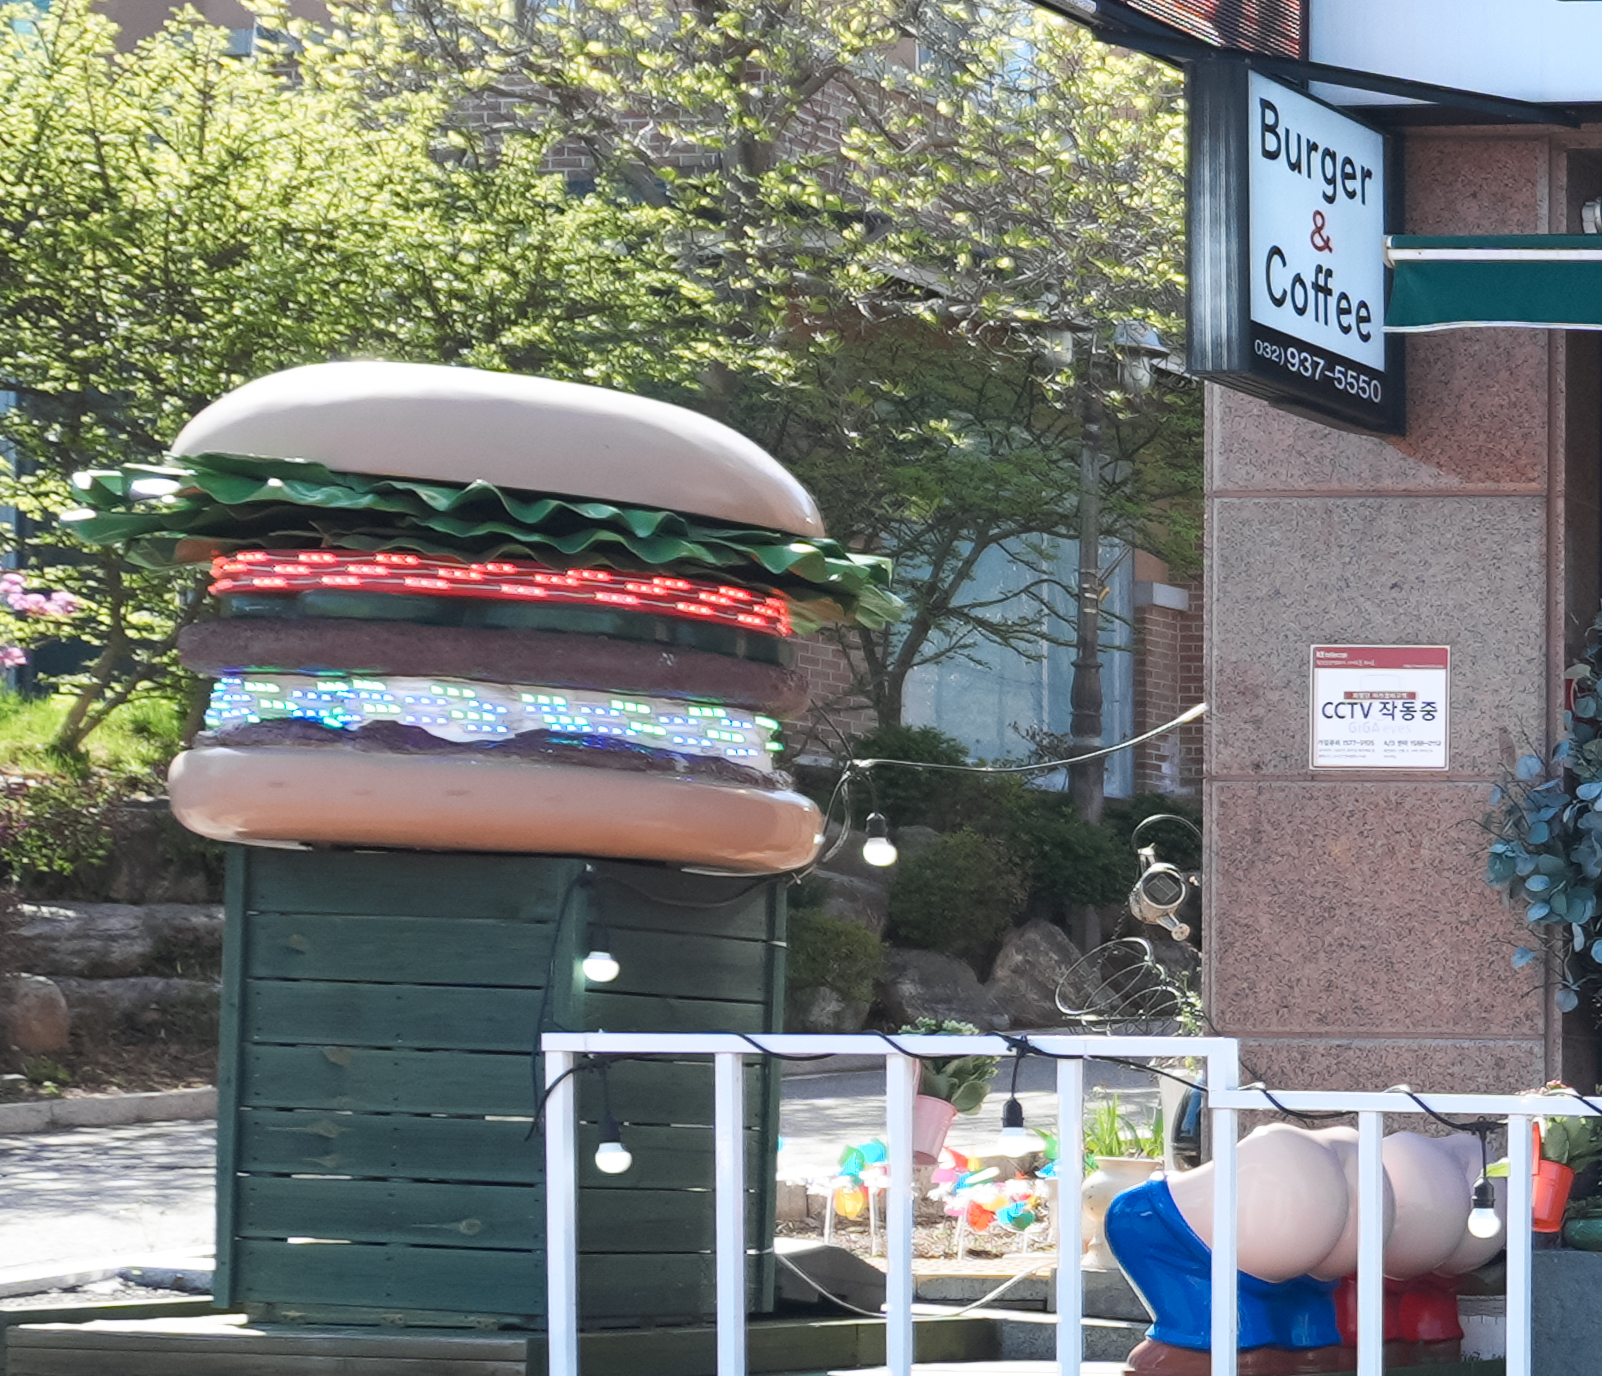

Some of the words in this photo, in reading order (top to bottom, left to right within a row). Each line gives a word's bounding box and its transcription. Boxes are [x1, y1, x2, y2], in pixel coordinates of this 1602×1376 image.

[1259, 97, 1373, 205] Burger
[1310, 210, 1333, 254] &
[1265, 245, 1372, 343] Coffee
[1321, 701, 1373, 719] CCTV
[1378, 700, 1438, 722] 작동중
